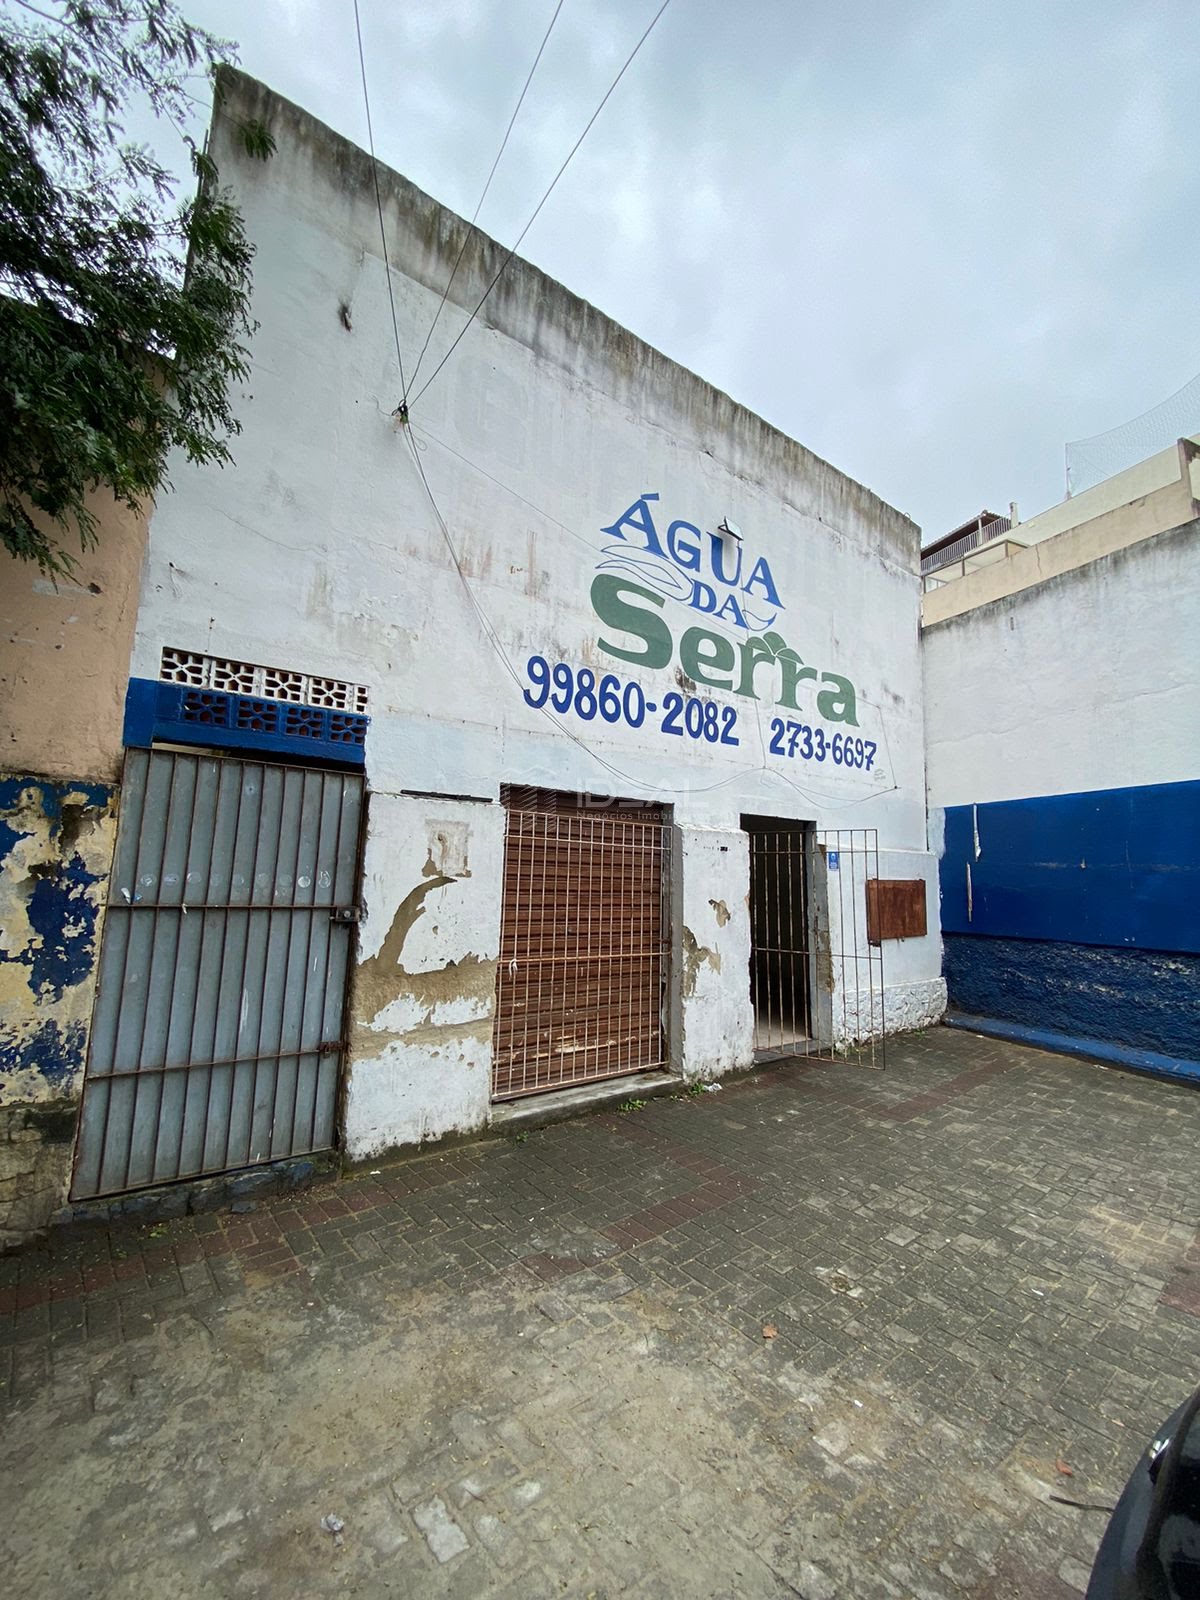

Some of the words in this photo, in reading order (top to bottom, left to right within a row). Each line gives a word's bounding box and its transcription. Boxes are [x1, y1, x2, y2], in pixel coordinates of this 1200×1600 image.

[600, 493, 786, 609] ÁGUA
[688, 578, 749, 630] DA
[590, 573, 860, 727] Serra
[523, 655, 740, 746] 99860-2082
[769, 718, 877, 771] 2733-6697
